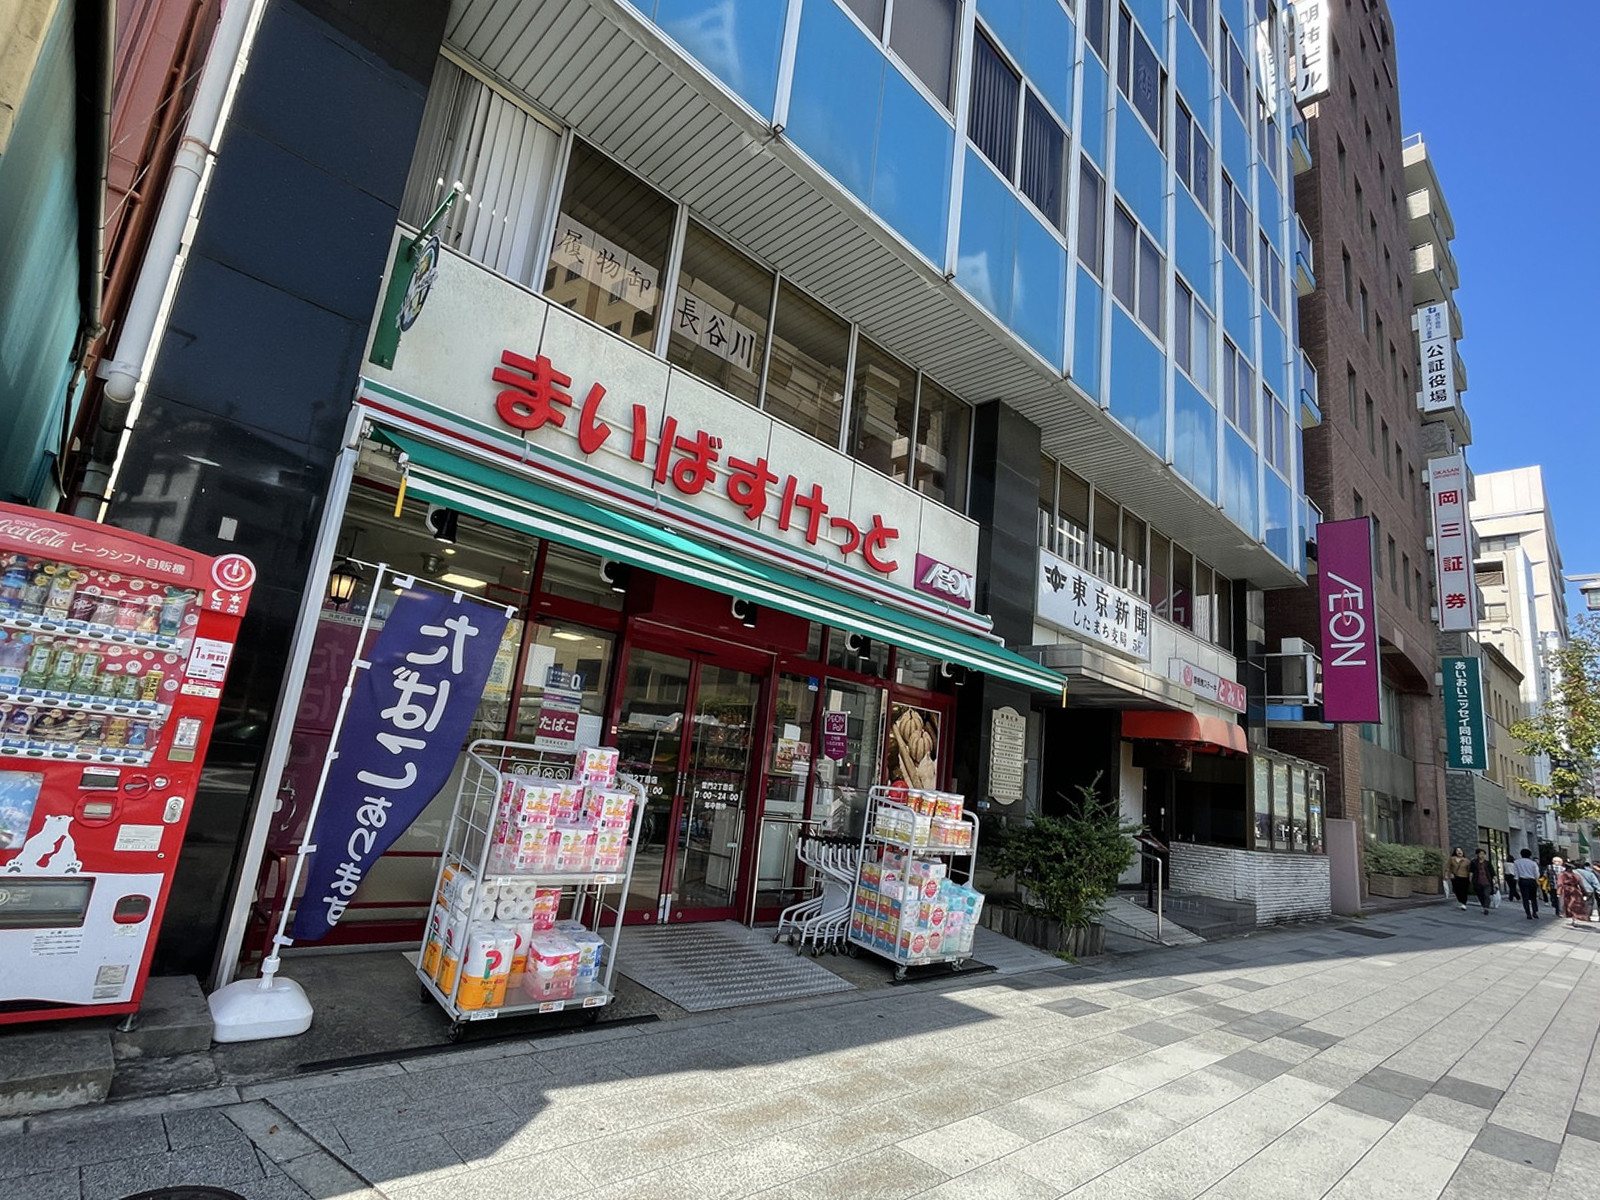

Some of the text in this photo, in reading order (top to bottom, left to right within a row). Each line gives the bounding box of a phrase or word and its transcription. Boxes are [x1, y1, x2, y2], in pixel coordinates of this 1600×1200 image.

[556, 228, 652, 298] 履物卸
[677, 297, 756, 369] 長谷川
[1427, 344, 1447, 402] 公証役場
[492, 349, 899, 573] まいばすけっと
[1438, 490, 1467, 610] 岡三証券
[1072, 574, 1148, 637] 東京新聞
[1073, 611, 1127, 648] したまち支局
[539, 715, 576, 734] たばこ
[1453, 661, 1474, 765] あいおいニッセイ同和損保
